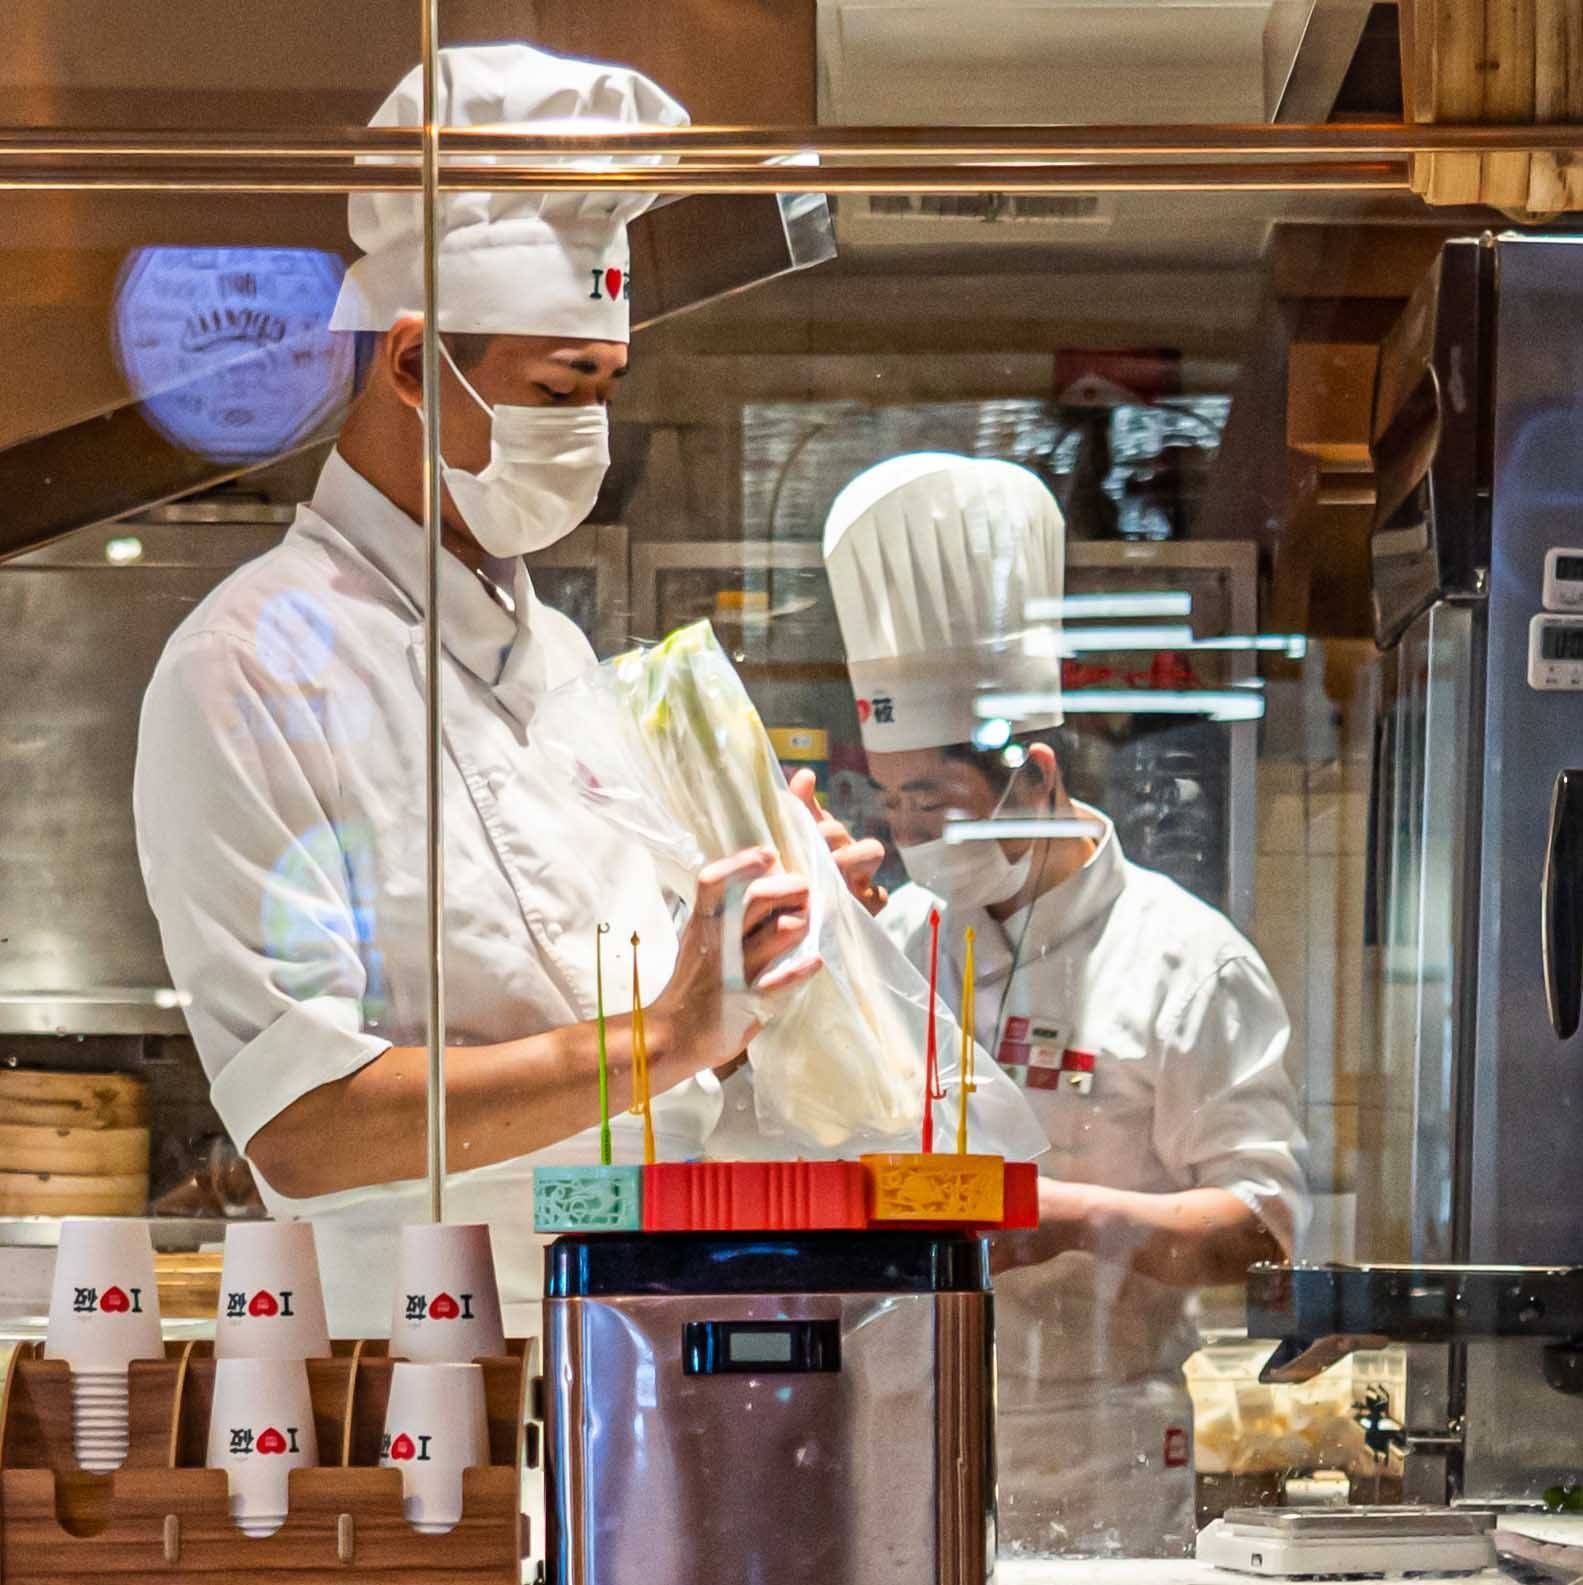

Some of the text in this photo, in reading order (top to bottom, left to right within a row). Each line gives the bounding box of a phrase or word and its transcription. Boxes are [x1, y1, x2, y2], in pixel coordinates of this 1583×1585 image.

[129, 1287, 143, 1313] I
[279, 1291, 294, 1316] I
[460, 1294, 474, 1319] I
[286, 1427, 300, 1453] I
[416, 1435, 432, 1460] I
